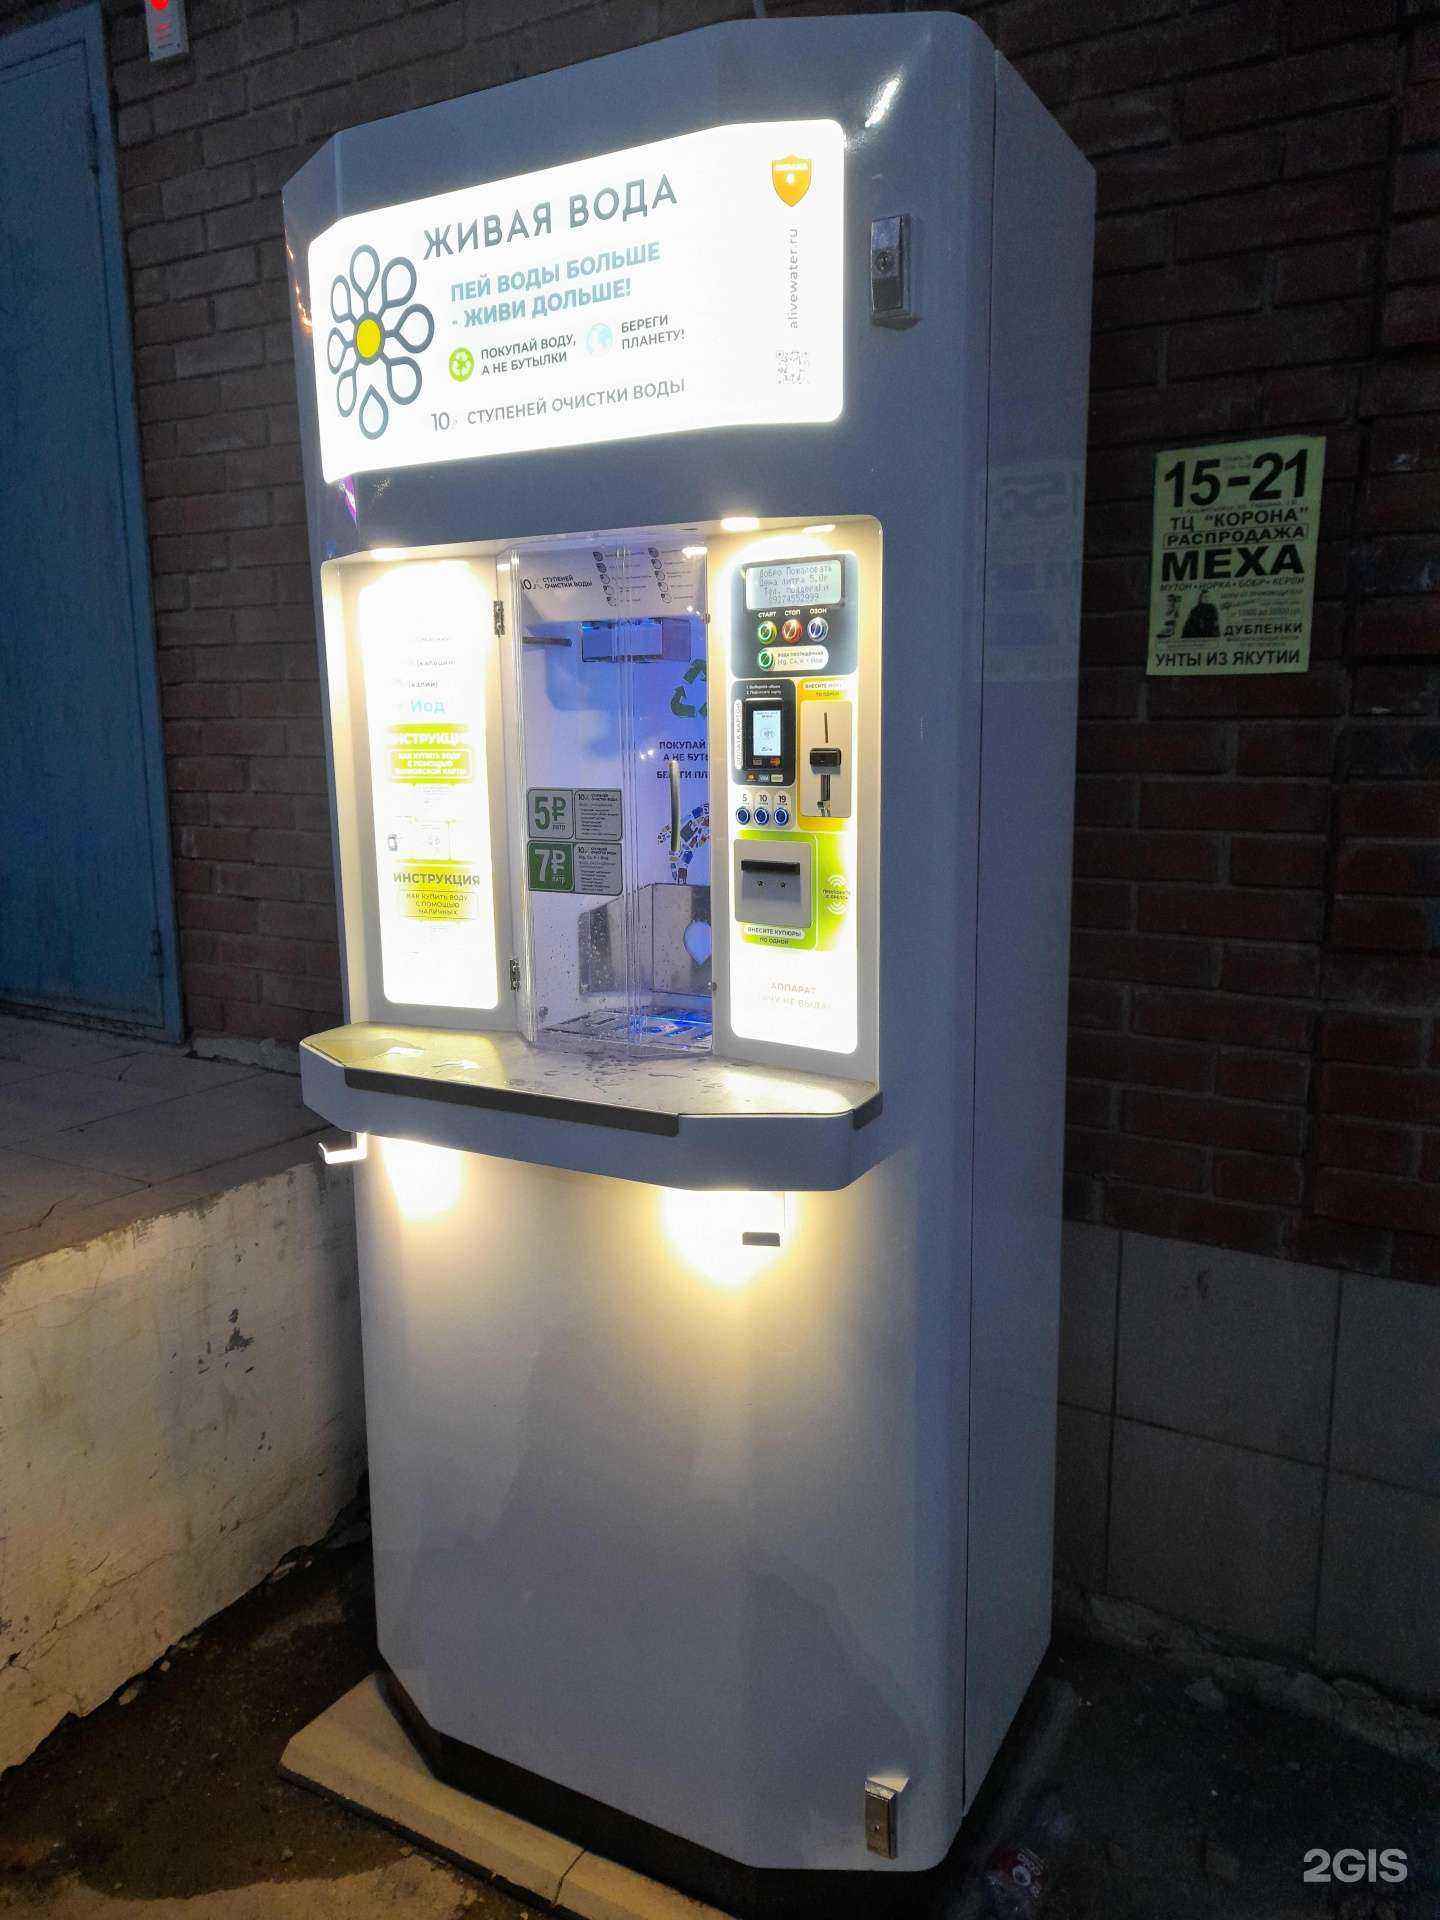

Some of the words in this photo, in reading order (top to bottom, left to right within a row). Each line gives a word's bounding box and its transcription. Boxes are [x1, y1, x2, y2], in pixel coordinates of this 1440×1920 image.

[423, 201, 552, 260] ЖИВАЯ
[569, 173, 678, 228] ВОДА
[451, 272, 491, 302] ПЕЙ
[497, 263, 560, 294] ВОДЫ
[566, 242, 661, 280] БОЛЬШЕ
[464, 301, 526, 328] ЖИВИ
[532, 277, 631, 318] ДОЛЬШЕ!
[621, 314, 669, 334] БЕРЕГИ
[481, 338, 538, 360] ПОКУПАЙ
[541, 333, 576, 350] ВОДУ,
[621, 329, 686, 350] ПЛАНЕТУ!
[480, 364, 490, 376] А
[493, 361, 507, 374] НЕ
[511, 351, 567, 371] БУТЫЛКИ
[467, 399, 547, 425] СТУПЕНЕЙ
[552, 387, 628, 412] ОЧИСТКИ
[633, 378, 685, 401] ВОДЫ
[1163, 448, 1309, 508] 15-21
[1170, 517, 1194, 532] ТЦ
[1167, 526, 1305, 547] РАСПРОДАЖА
[1161, 544, 1305, 582] МЕХА
[809, 607, 827, 615] ОЗОН
[1224, 622, 1303, 637] ДУБЛЕНКИ
[1155, 651, 1201, 668] УНТЫ
[1206, 650, 1228, 666] ИЗ
[1232, 649, 1300, 666] ЯКУТИИ
[410, 698, 447, 714] Йод
[659, 739, 705, 749] ПОКУПАЙ
[664, 753, 669, 761] А
[672, 753, 685, 761] НЕ
[656, 770, 692, 779] БЕГИ
[742, 793, 747, 801] 5
[759, 794, 767, 802] 10
[778, 795, 786, 803] 19
[393, 872, 480, 887] ИНСТРУКЦИЯ
